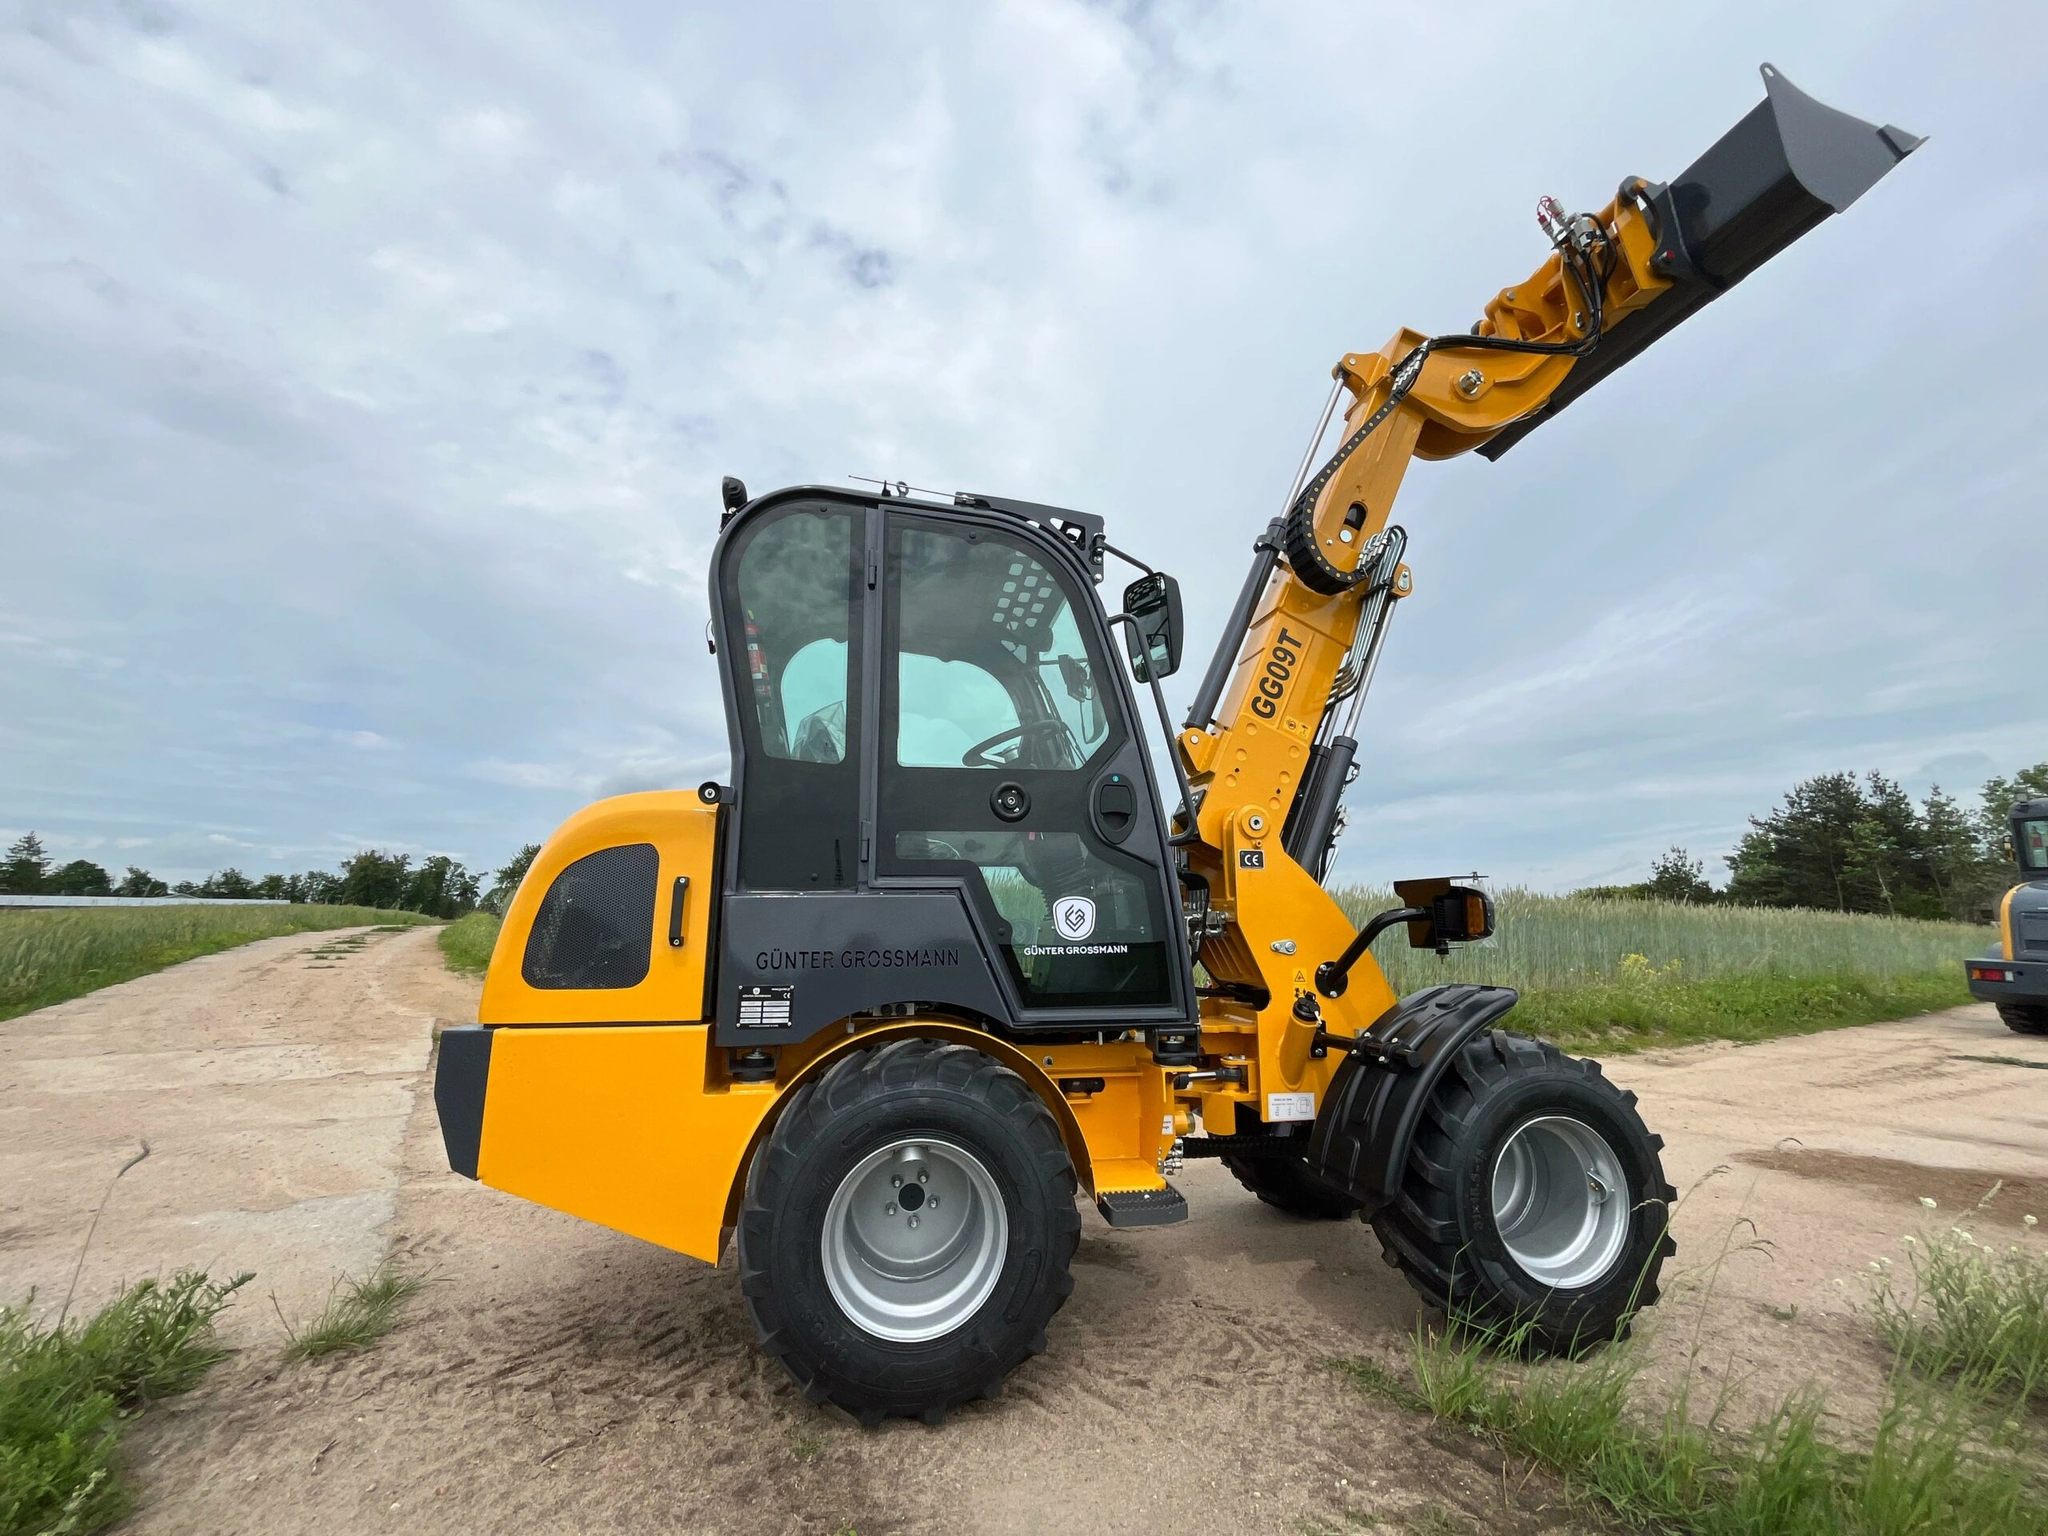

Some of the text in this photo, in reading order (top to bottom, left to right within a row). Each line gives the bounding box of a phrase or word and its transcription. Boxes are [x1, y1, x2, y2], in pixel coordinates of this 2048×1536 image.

[1251, 627, 1302, 719] GG09T
[1244, 854, 1259, 866] CE
[1023, 945, 1128, 956] GÜNTER GROSSMANN
[756, 949, 959, 970] GÜNTER GROSSMANN
